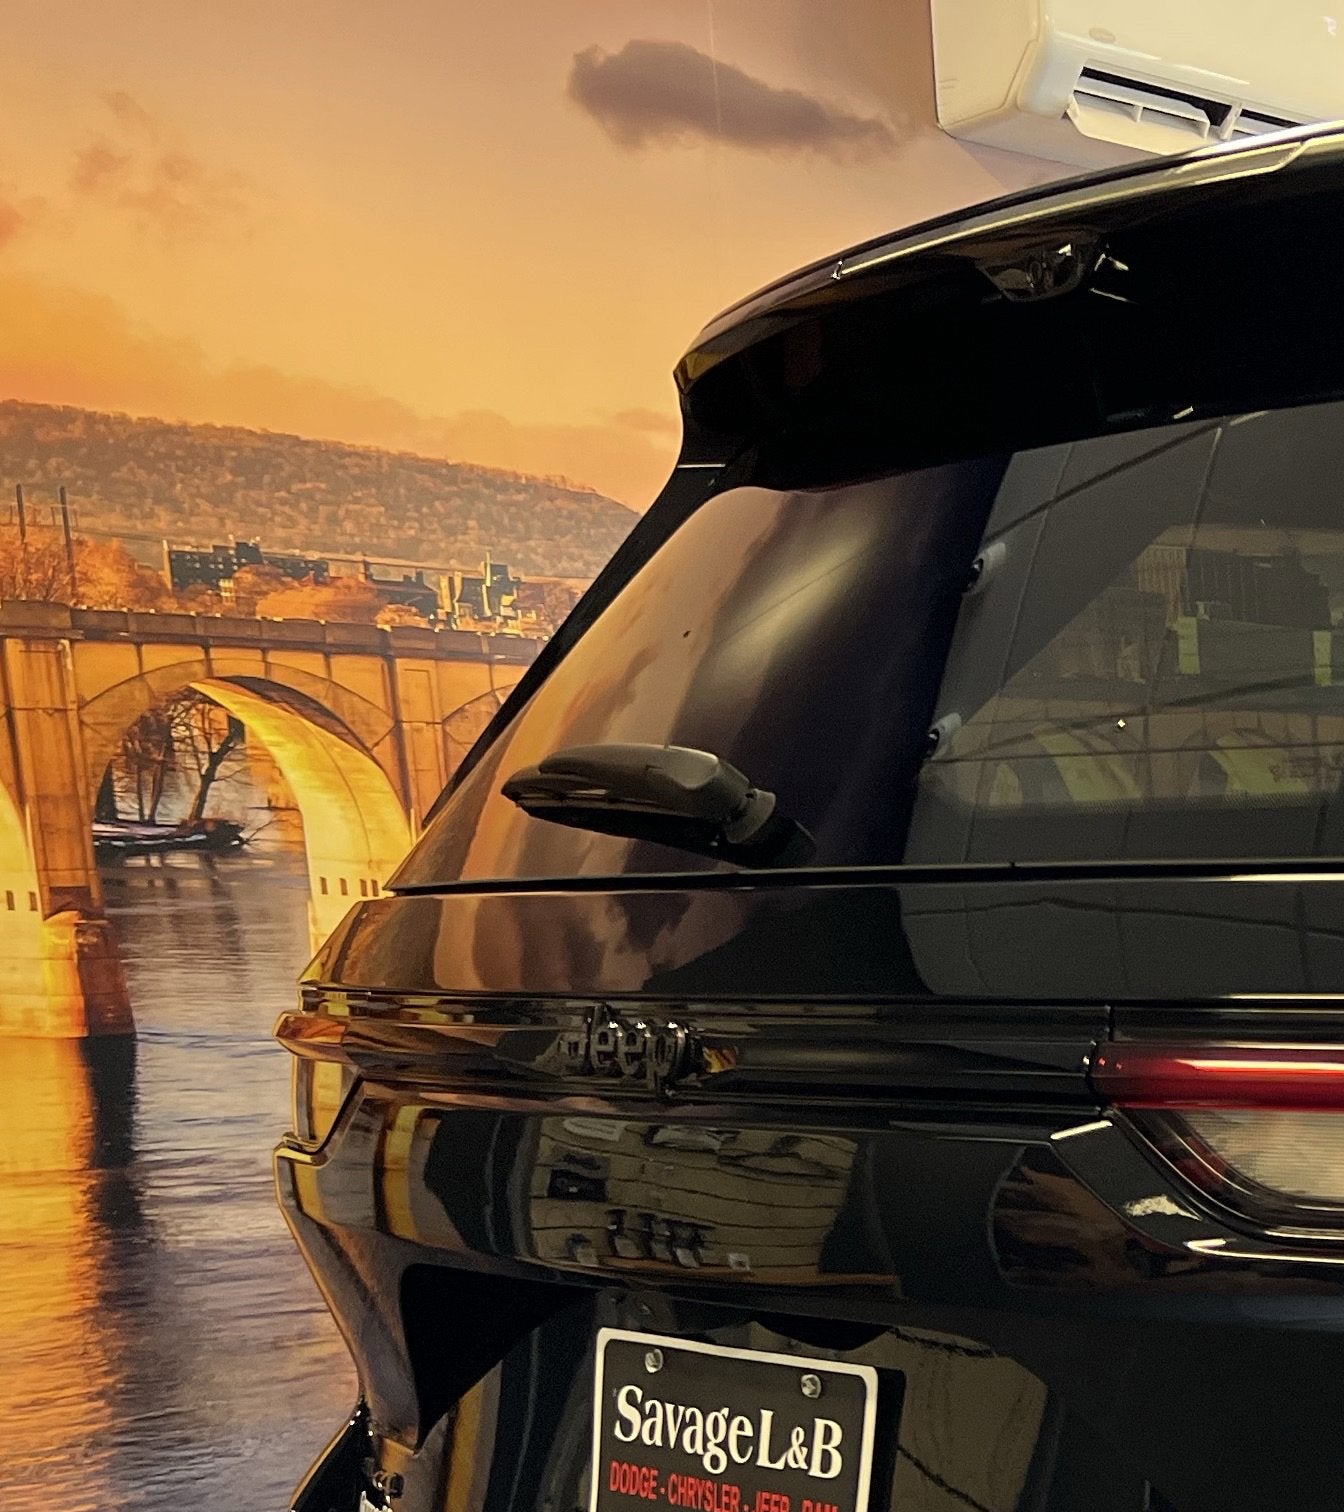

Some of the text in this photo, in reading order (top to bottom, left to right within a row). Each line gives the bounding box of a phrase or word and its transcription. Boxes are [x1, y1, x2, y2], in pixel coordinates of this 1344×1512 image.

[614, 1385, 843, 1479] Savage L&B
[609, 1461, 659, 1500] DODGE
